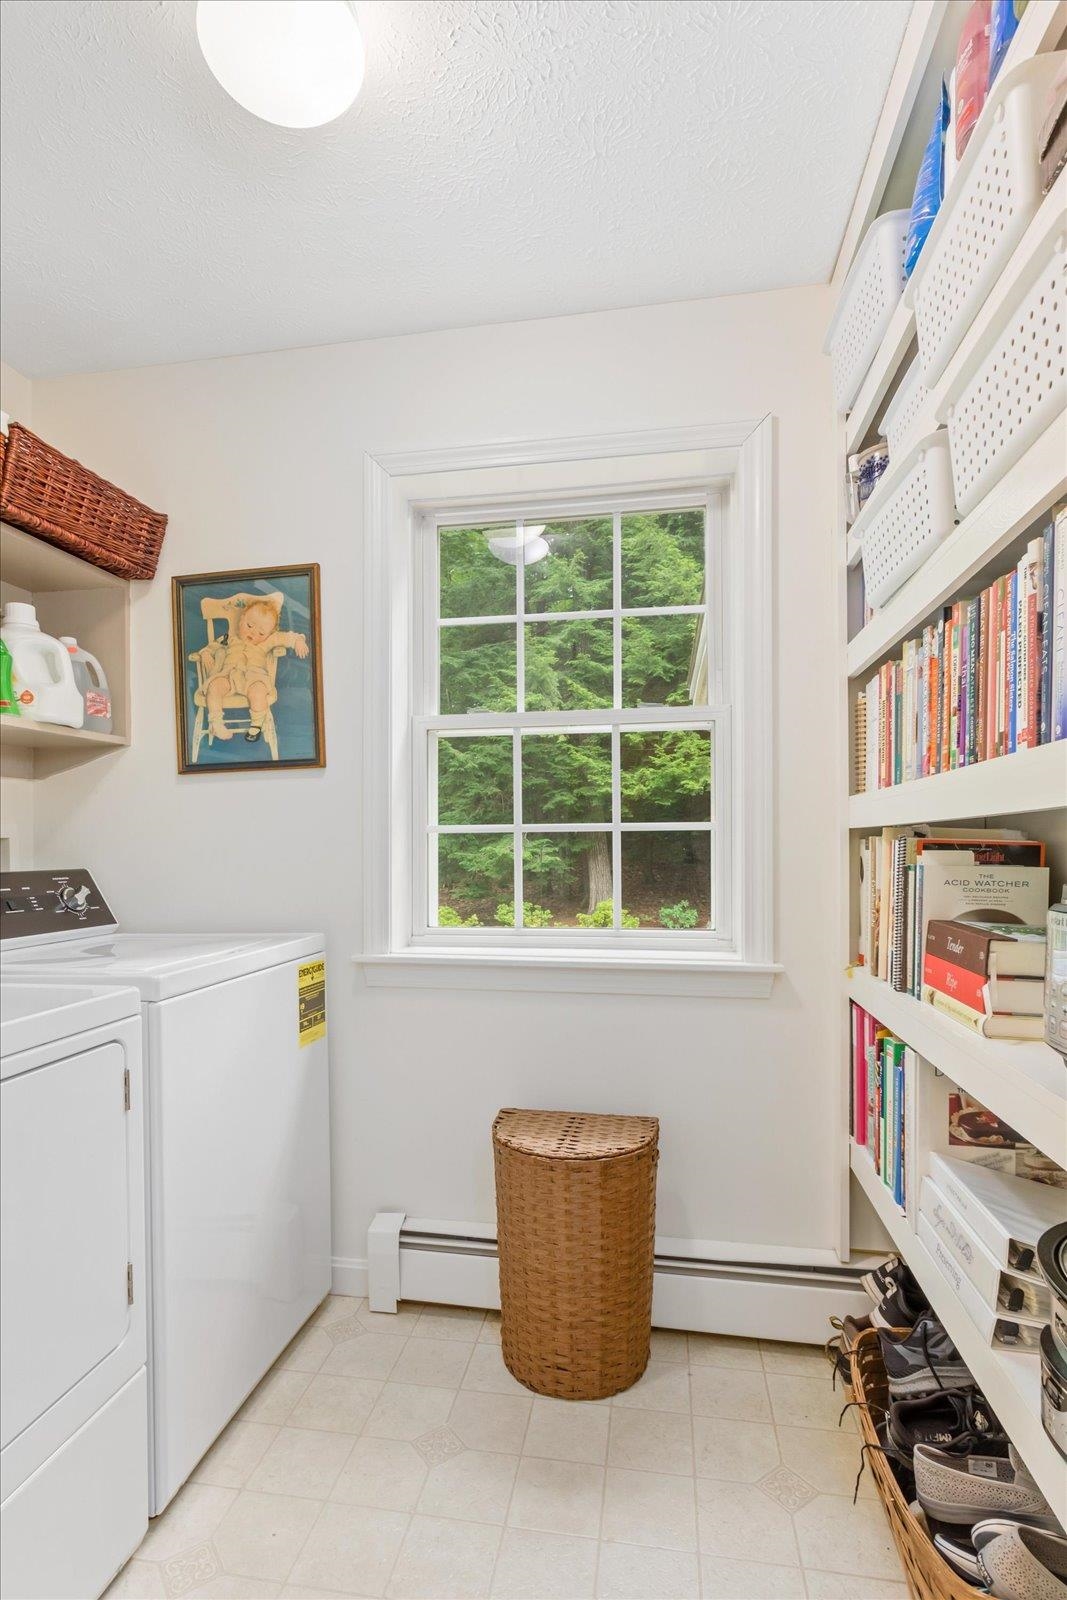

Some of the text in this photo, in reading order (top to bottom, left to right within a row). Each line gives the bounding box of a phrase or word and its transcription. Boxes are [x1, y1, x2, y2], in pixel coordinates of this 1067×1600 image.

[1041, 639, 1049, 675] EATS
[943, 879, 1030, 888] ACID WATCHER
[946, 936, 965, 955] Tender
